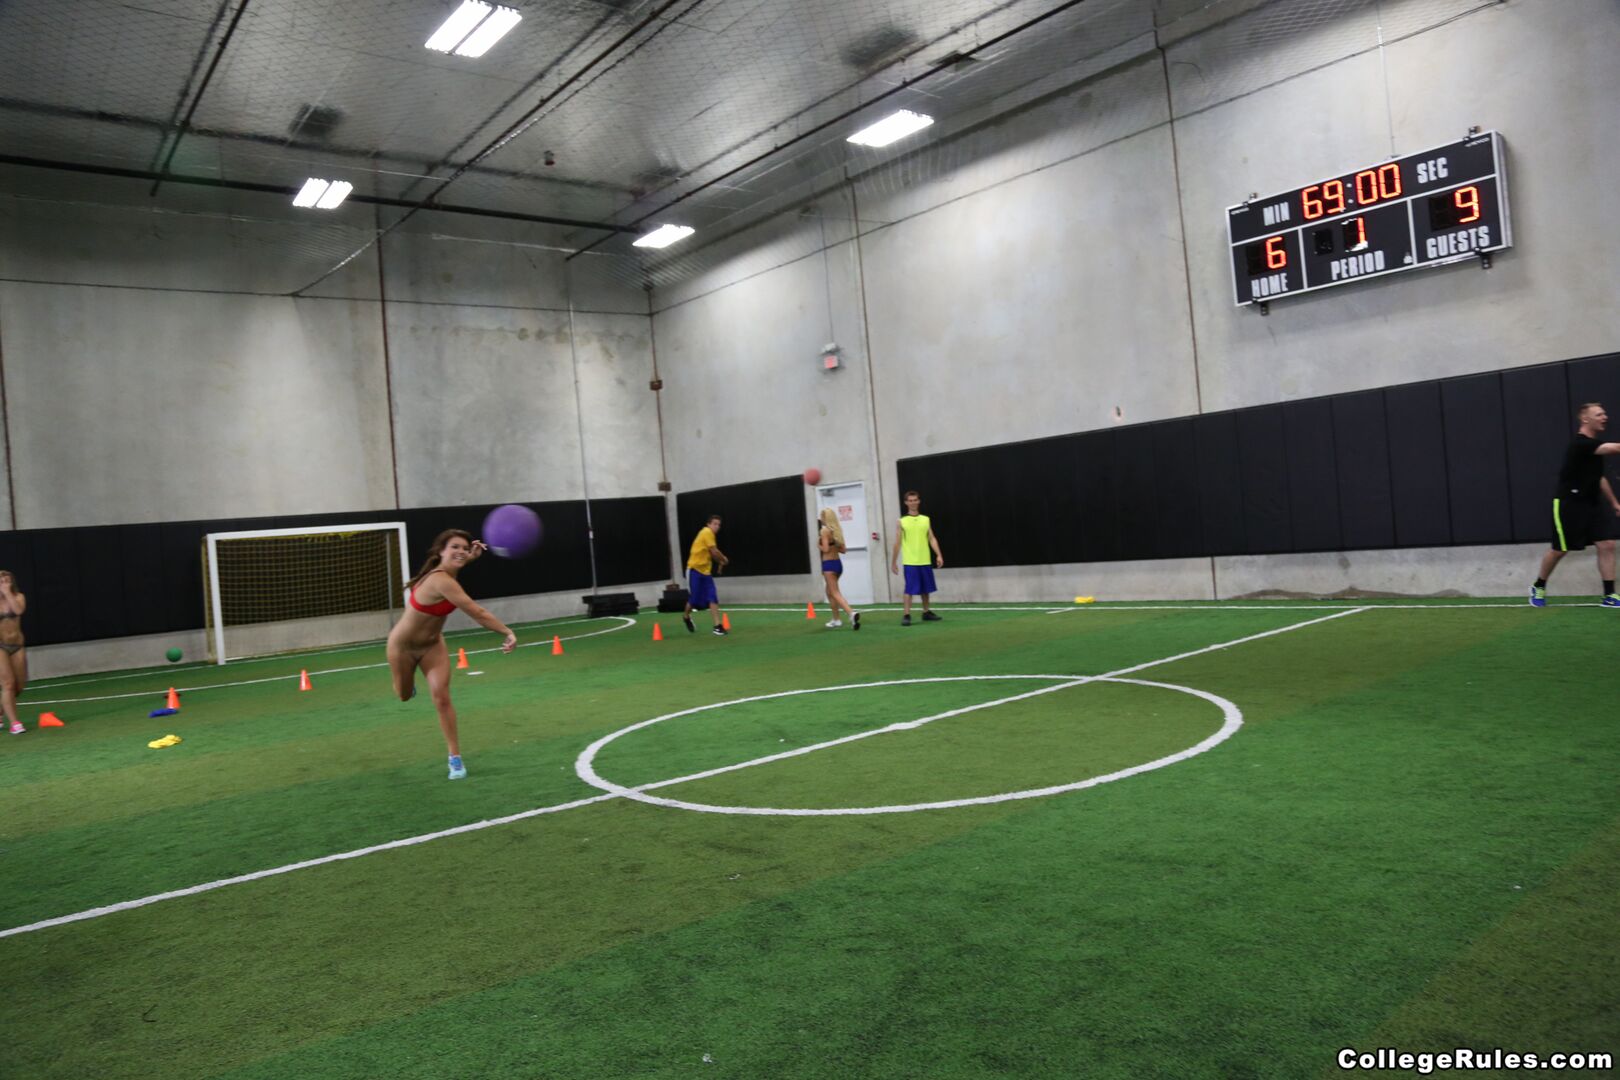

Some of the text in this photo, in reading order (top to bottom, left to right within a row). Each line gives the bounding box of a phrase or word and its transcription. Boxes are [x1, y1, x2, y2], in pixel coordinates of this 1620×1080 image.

[1263, 157, 1449, 226] MIN 69:00 SEC
[1454, 186, 1480, 223] 9
[1265, 237, 1287, 269] 6
[1426, 226, 1490, 259] GUESTS
[1331, 251, 1385, 280] PERIOD
[1251, 273, 1288, 298] HOME
